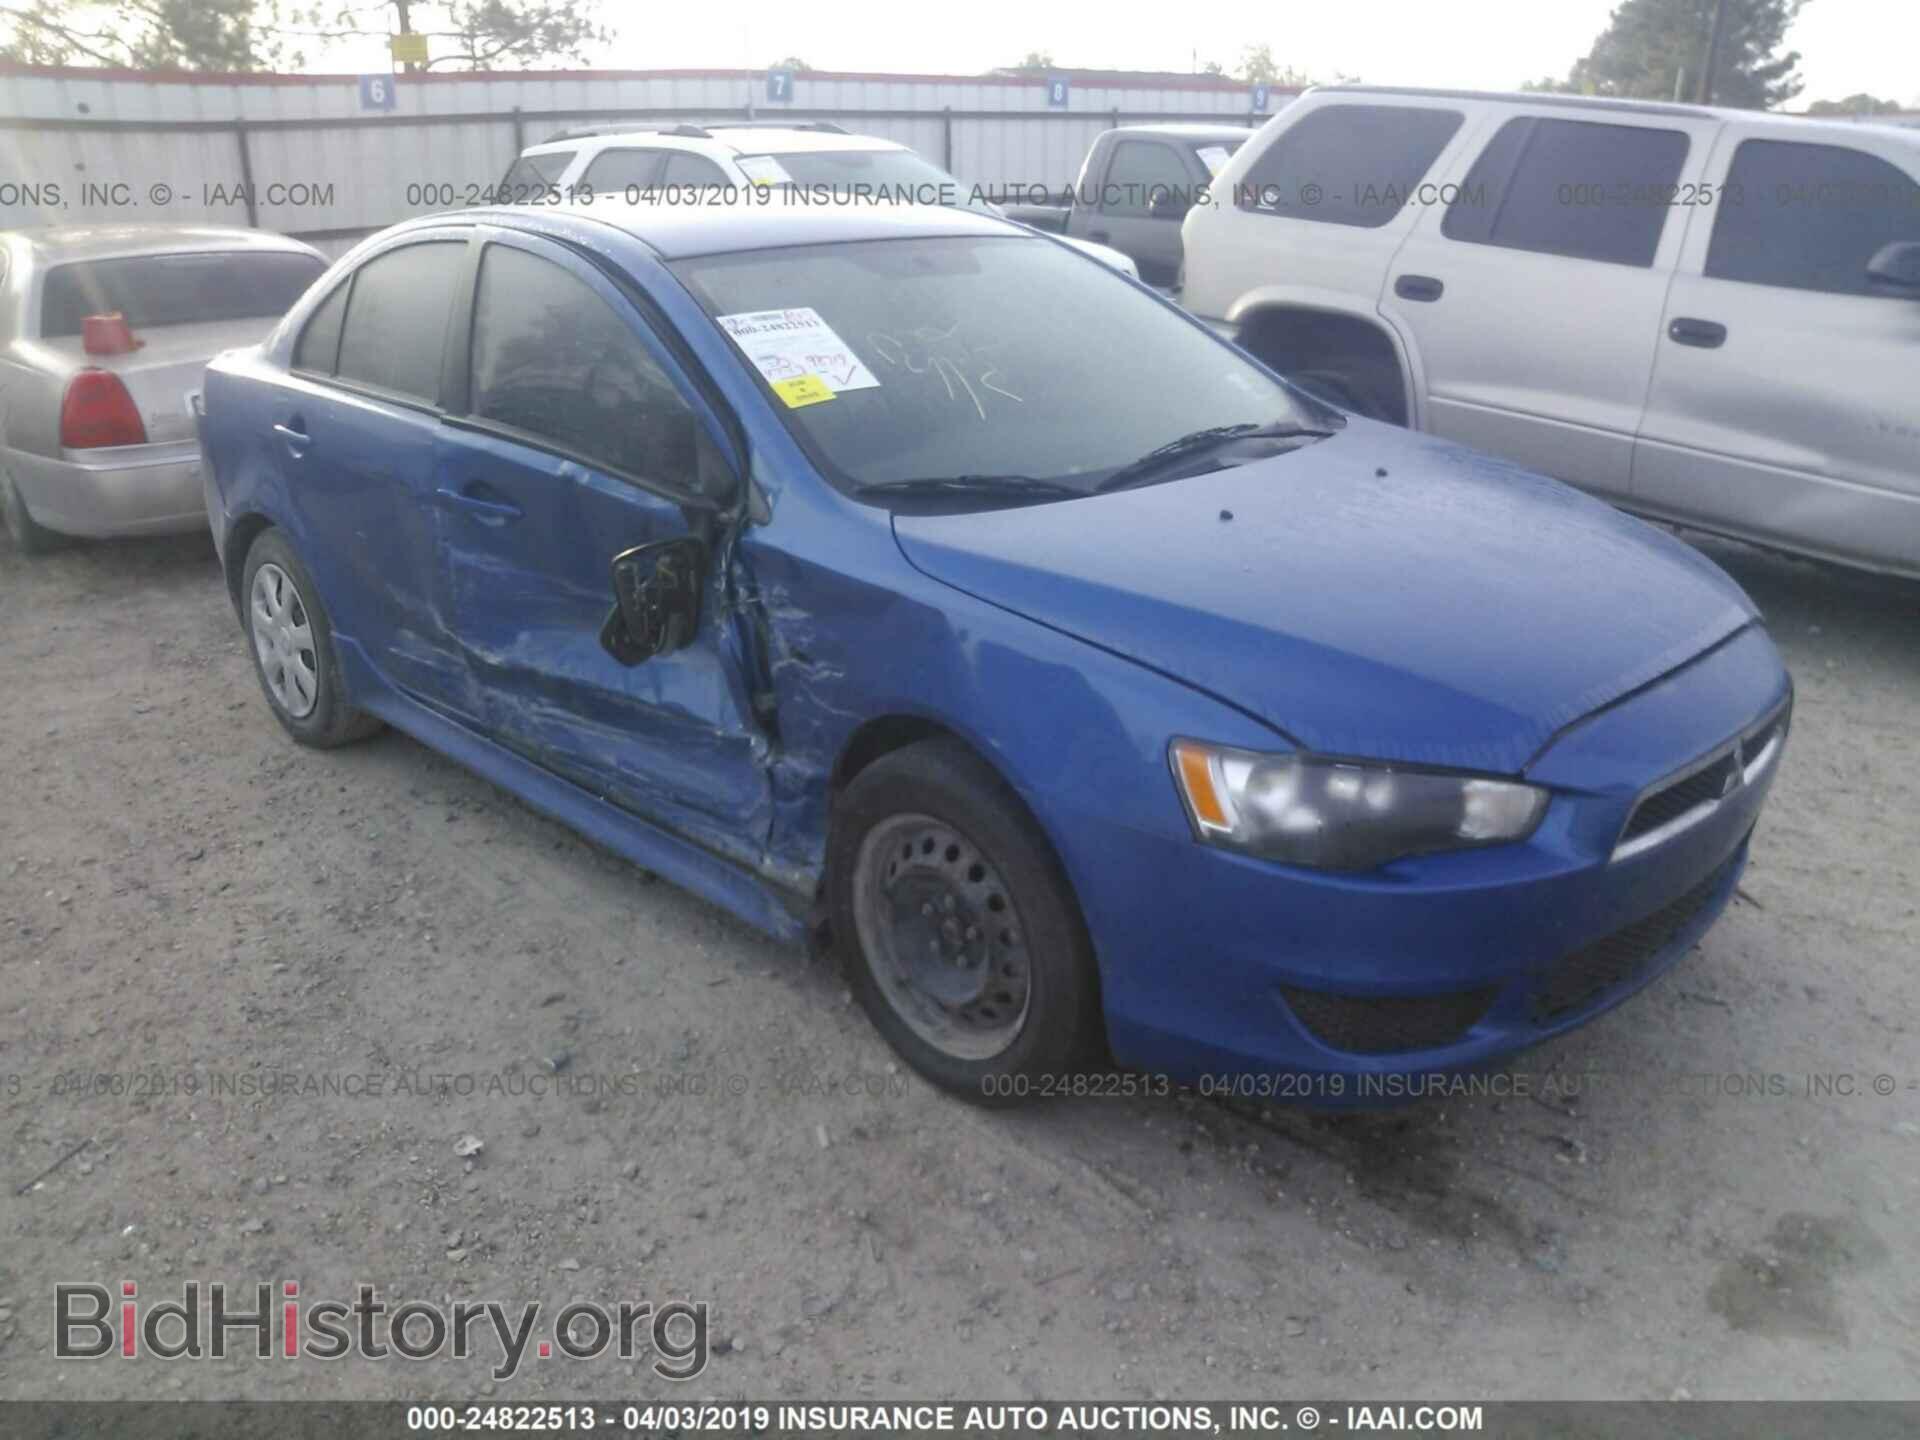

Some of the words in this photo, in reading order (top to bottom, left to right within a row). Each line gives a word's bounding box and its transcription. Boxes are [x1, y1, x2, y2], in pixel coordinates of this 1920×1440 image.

[371, 79, 385, 103] 6
[774, 75, 785, 96] 7
[1054, 83, 1063, 101] 8
